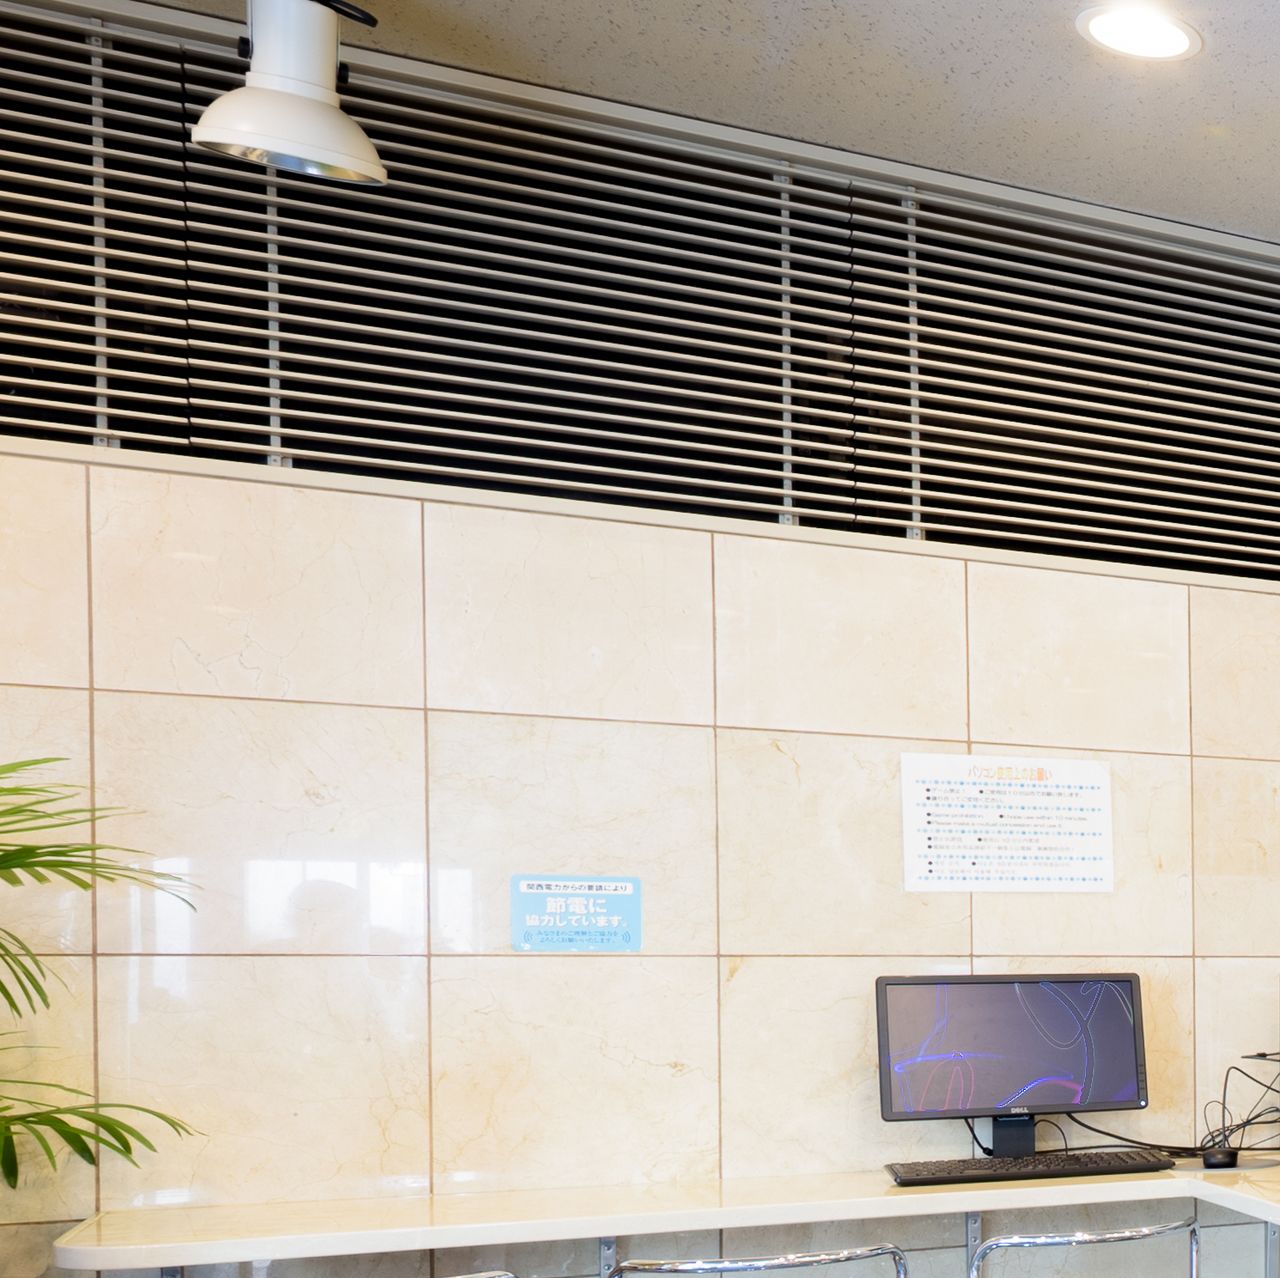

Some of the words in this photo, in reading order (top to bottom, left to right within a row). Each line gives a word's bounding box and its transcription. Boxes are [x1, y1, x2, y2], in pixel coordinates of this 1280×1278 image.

[526, 883, 628, 892] 関西電力からの要請により
[546, 897, 608, 914] 節電に
[525, 914, 628, 927] 協力しています。
[1010, 1106, 1029, 1114] DELL
